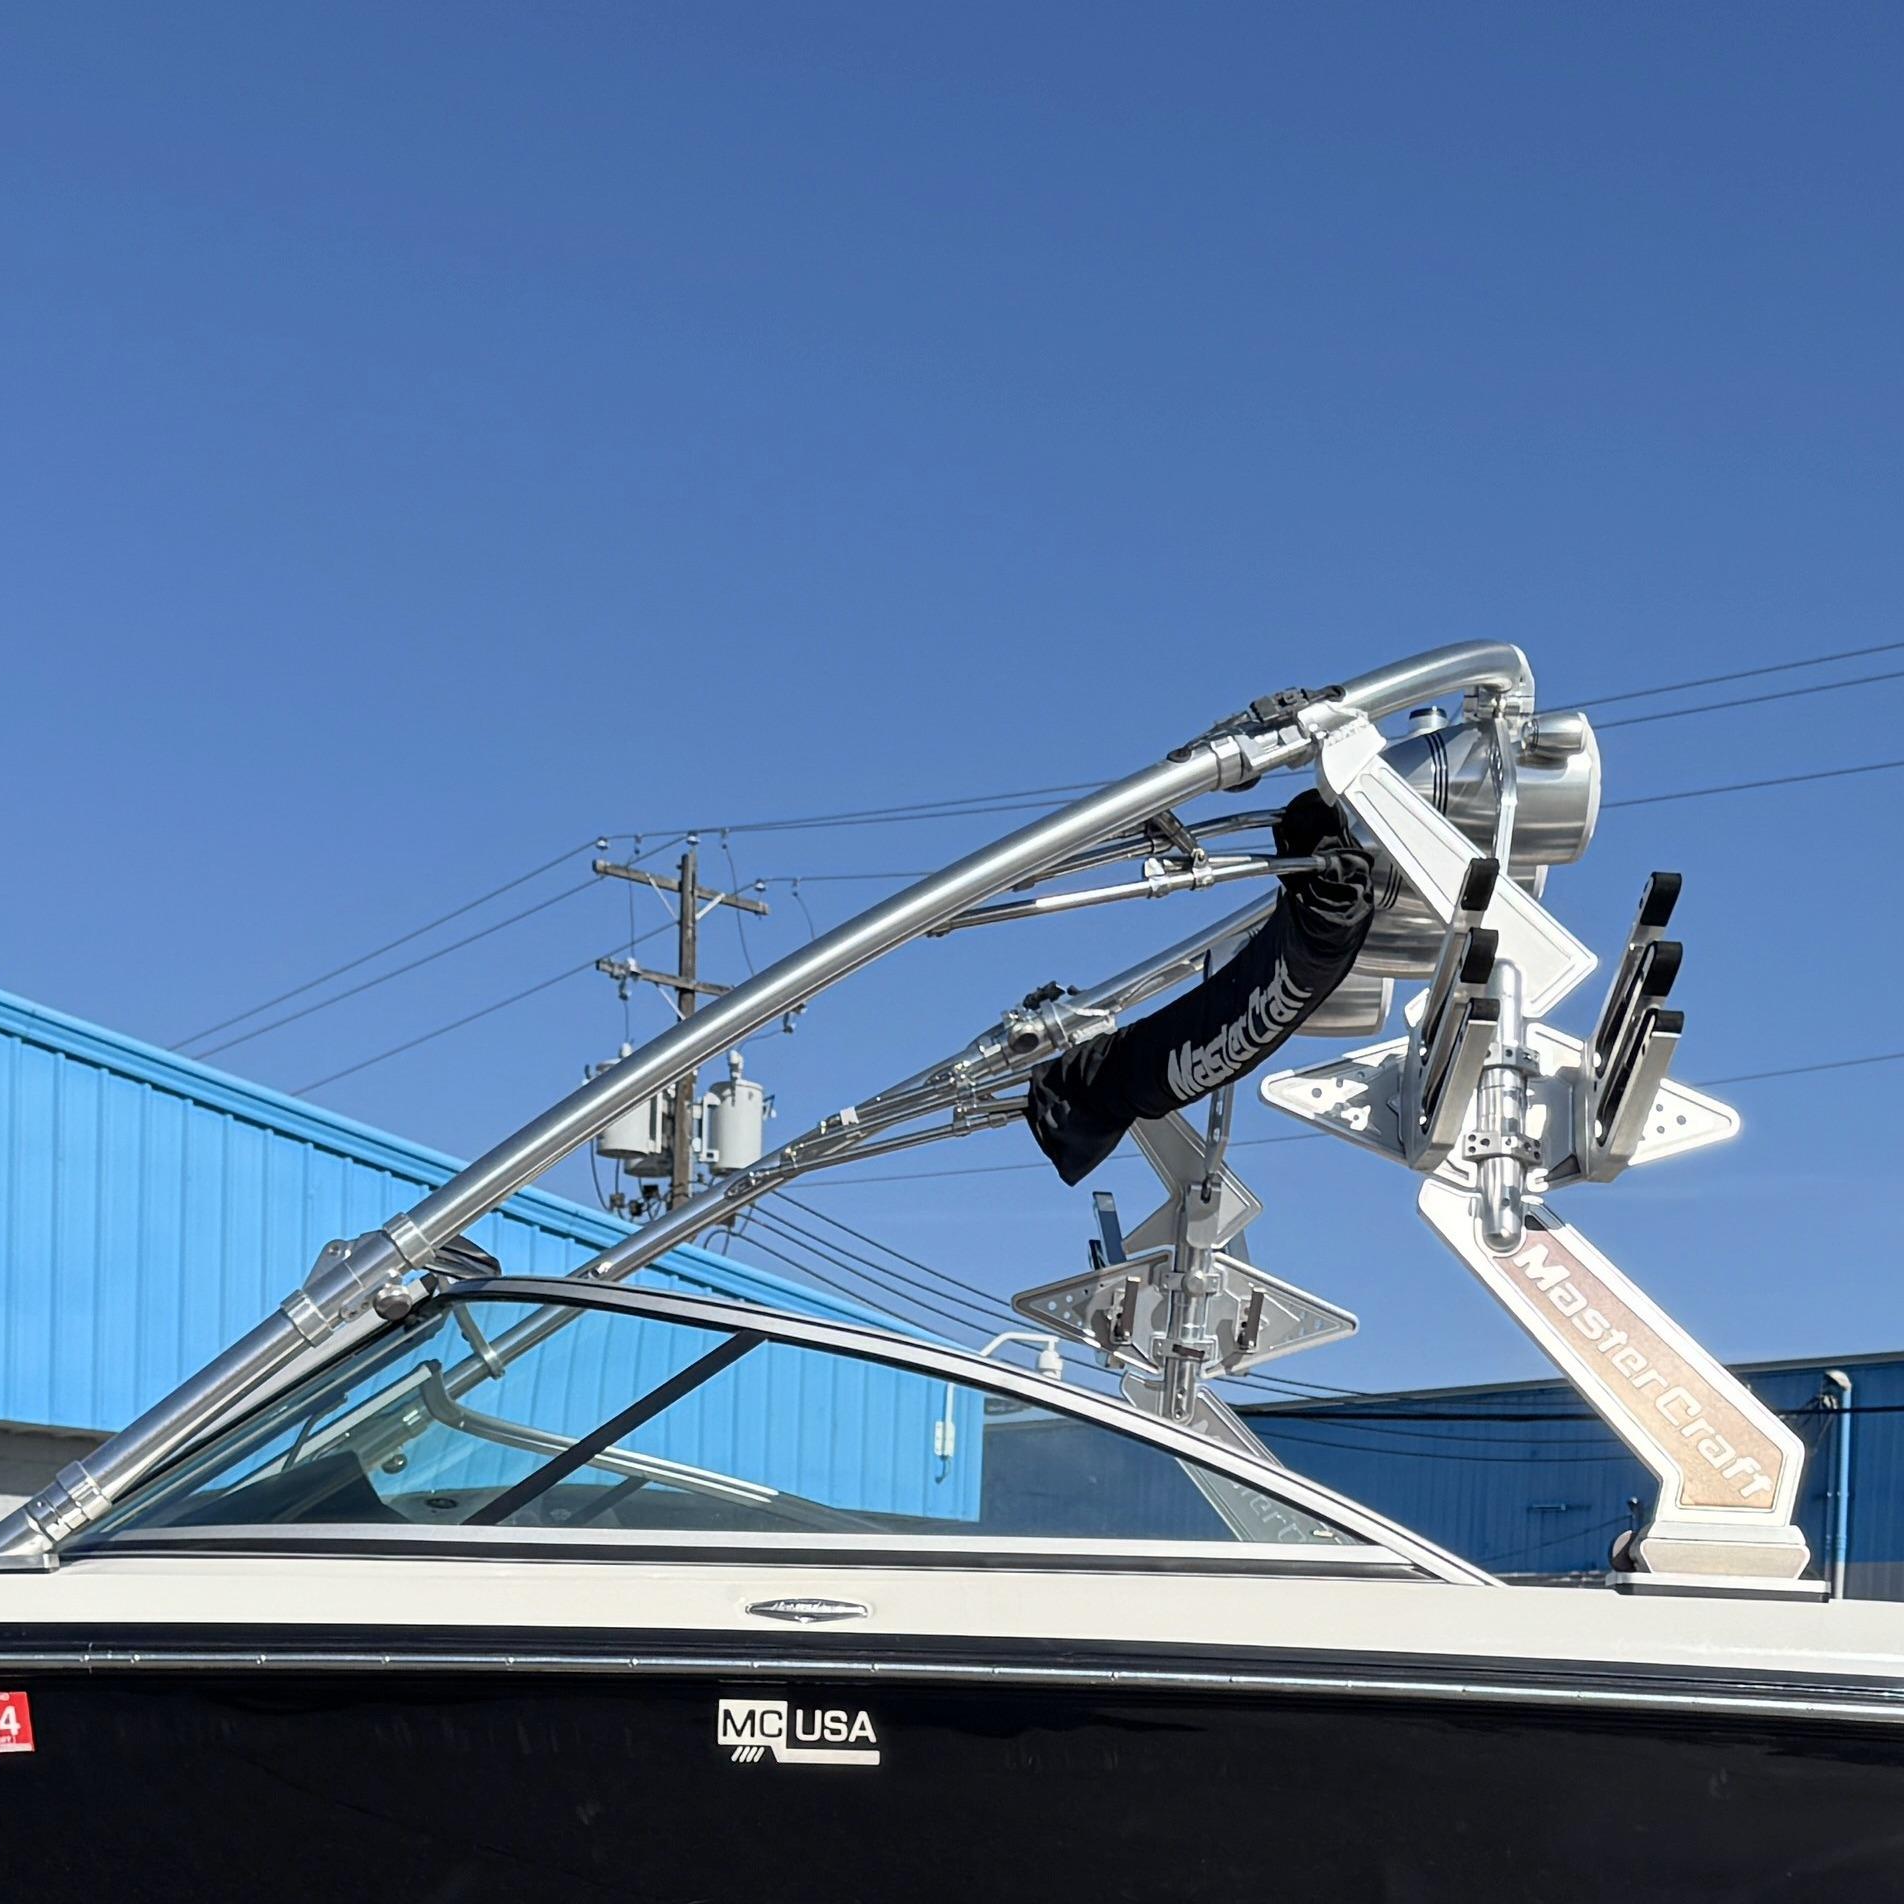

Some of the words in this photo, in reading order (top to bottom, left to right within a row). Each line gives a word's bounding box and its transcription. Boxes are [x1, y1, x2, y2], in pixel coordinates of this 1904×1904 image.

[1168, 954, 1312, 1101] MasterCraft
[1513, 1243, 1774, 1499] MasterCraft
[722, 1709, 783, 1738] MC
[796, 1709, 877, 1744] USA
